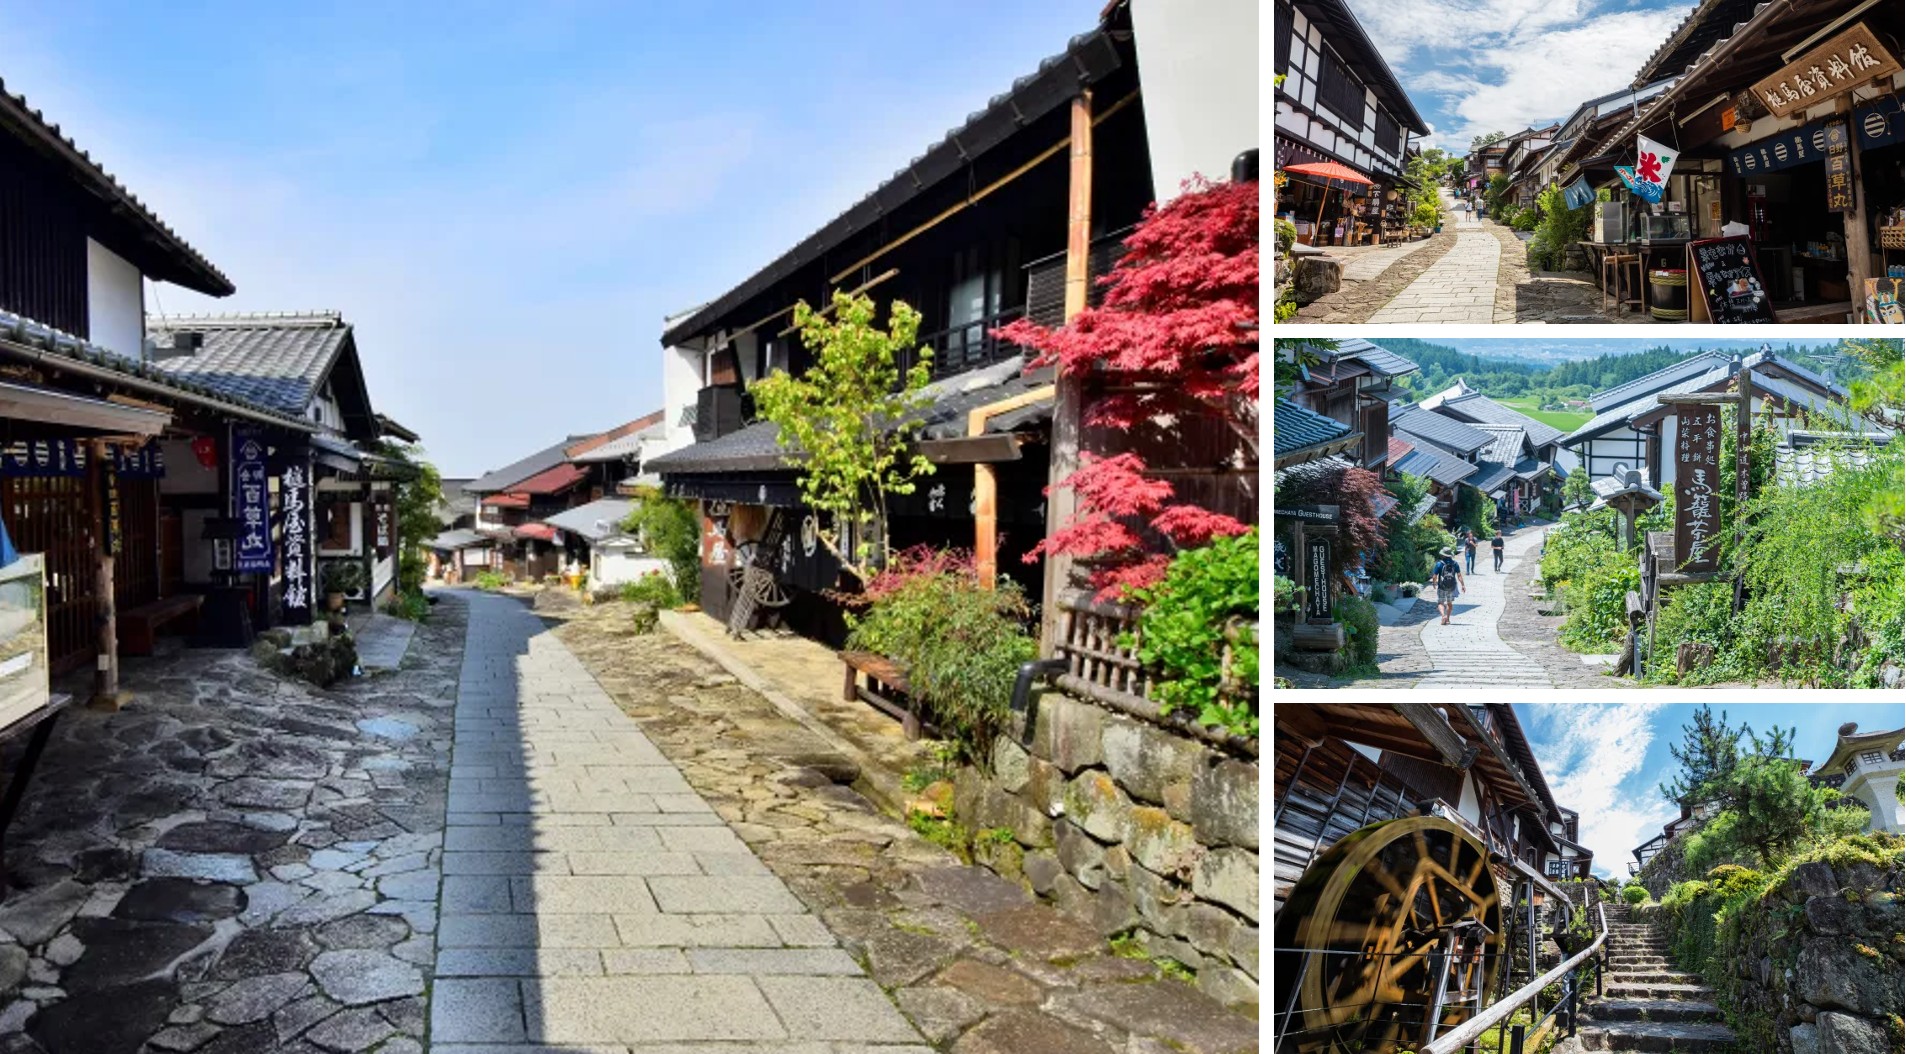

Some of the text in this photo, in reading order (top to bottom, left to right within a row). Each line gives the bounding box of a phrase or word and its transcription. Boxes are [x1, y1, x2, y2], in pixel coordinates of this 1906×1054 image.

[1636, 150, 1662, 183] 氷
[1692, 416, 1702, 462] 五平餅
[1704, 413, 1717, 466] お食事処
[1298, 509, 1333, 520] GUESTHOUSE
[1683, 468, 1712, 564] 馬籠茶屋
[1312, 545, 1321, 616] MAGOMECHAYA
[1319, 545, 1327, 612] GUESTHOUSE
